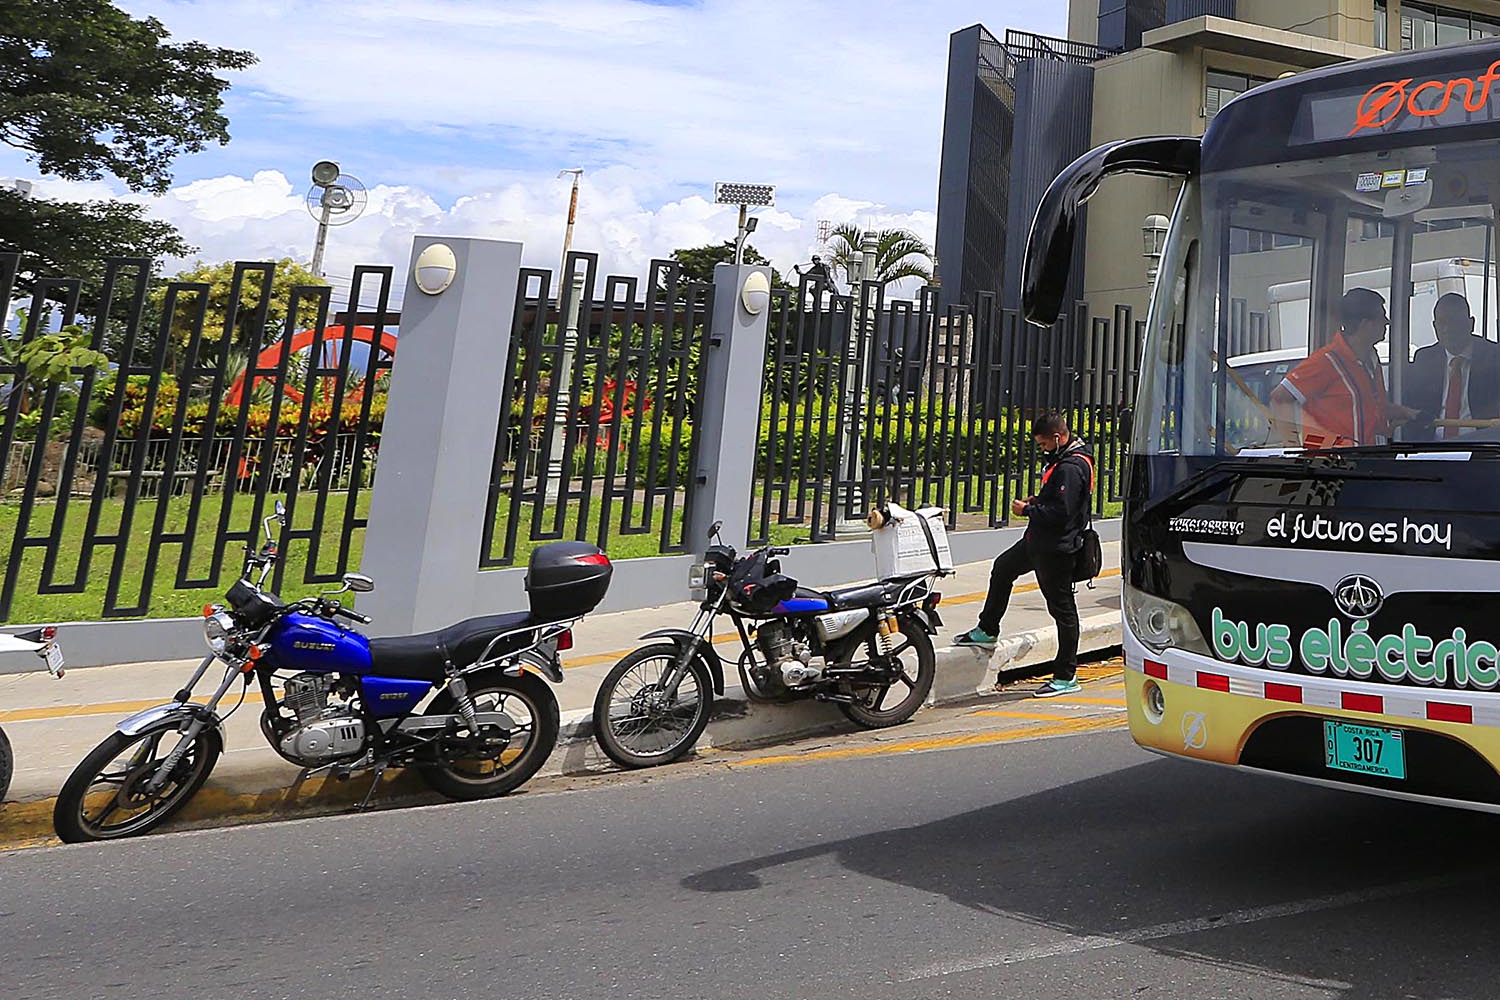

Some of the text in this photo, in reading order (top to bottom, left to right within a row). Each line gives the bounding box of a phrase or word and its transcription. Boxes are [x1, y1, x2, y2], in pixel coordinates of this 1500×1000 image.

[1266, 513, 1451, 550] el futuro es hoy
[1212, 607, 1293, 670] bus
[1343, 726, 1380, 737] COSTA RICA
[1352, 736, 1384, 764] 307
